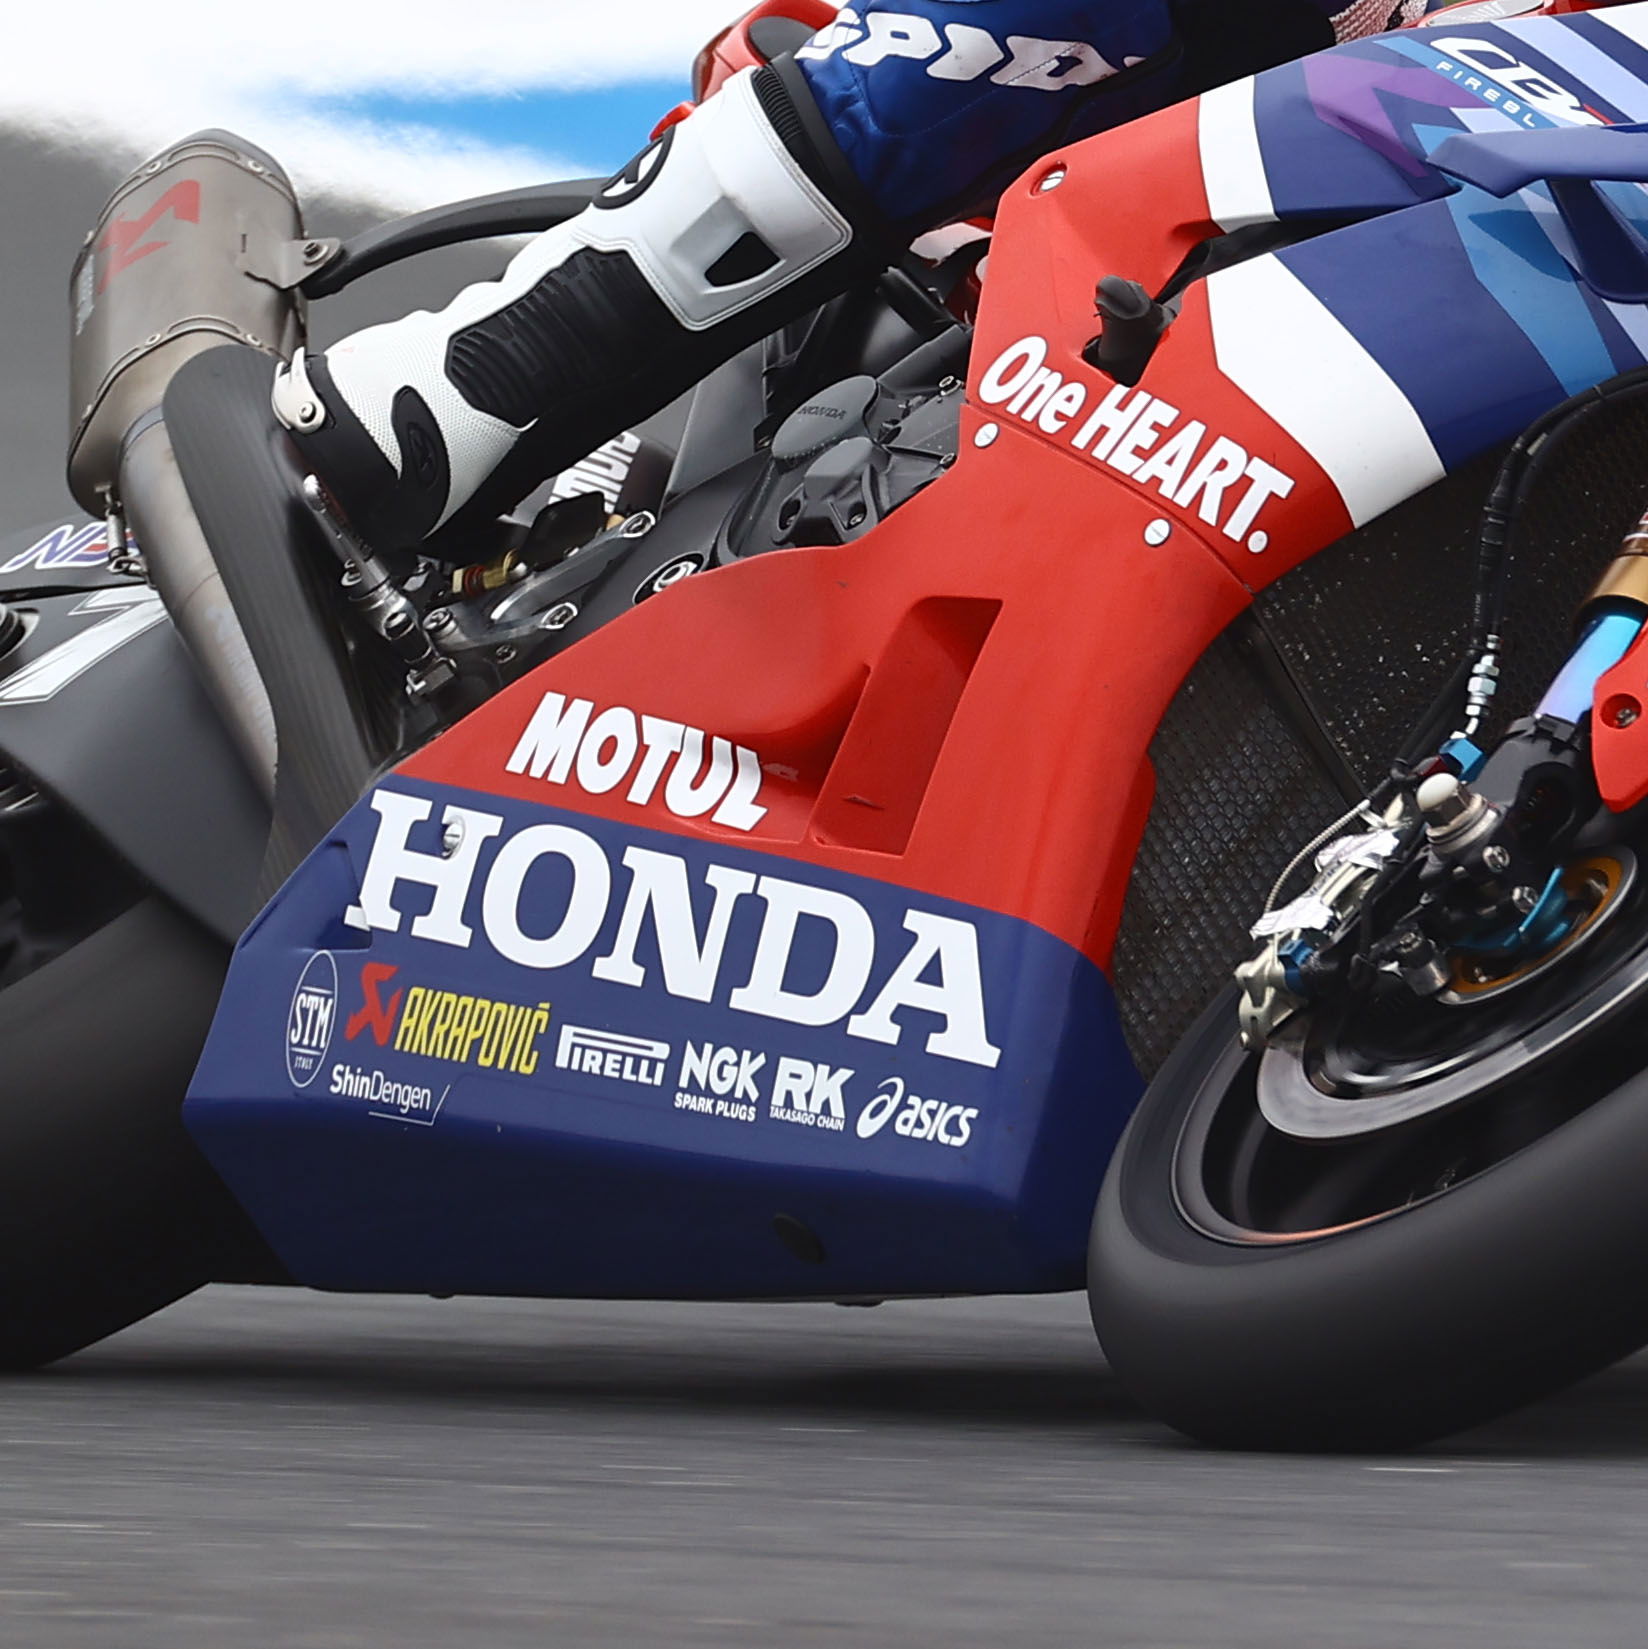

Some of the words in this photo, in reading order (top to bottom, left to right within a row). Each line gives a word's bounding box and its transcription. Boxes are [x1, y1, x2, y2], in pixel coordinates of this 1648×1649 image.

[794, 8, 1147, 92] SPID
[1436, 61, 1535, 128] FIREBL
[979, 336, 1087, 434] One
[1070, 382, 1295, 554] HEART.
[505, 691, 768, 831] MOTUL
[344, 788, 1001, 1068] HONDA
[291, 992, 333, 1049] STM
[394, 986, 551, 1075] AKRAPOVIĆ
[294, 1055, 313, 1070] ITALY
[555, 1024, 670, 1086] PIRELLI
[678, 1040, 766, 1102] NGK
[330, 1063, 431, 1113] ShinDengen
[674, 1092, 713, 1114] SPARK
[716, 1100, 756, 1122] PLUGS
[771, 1056, 855, 1118] RK
[770, 1106, 816, 1126] TAKASAGO
[817, 1115, 845, 1132] CHAIN
[894, 1095, 979, 1147] asics
